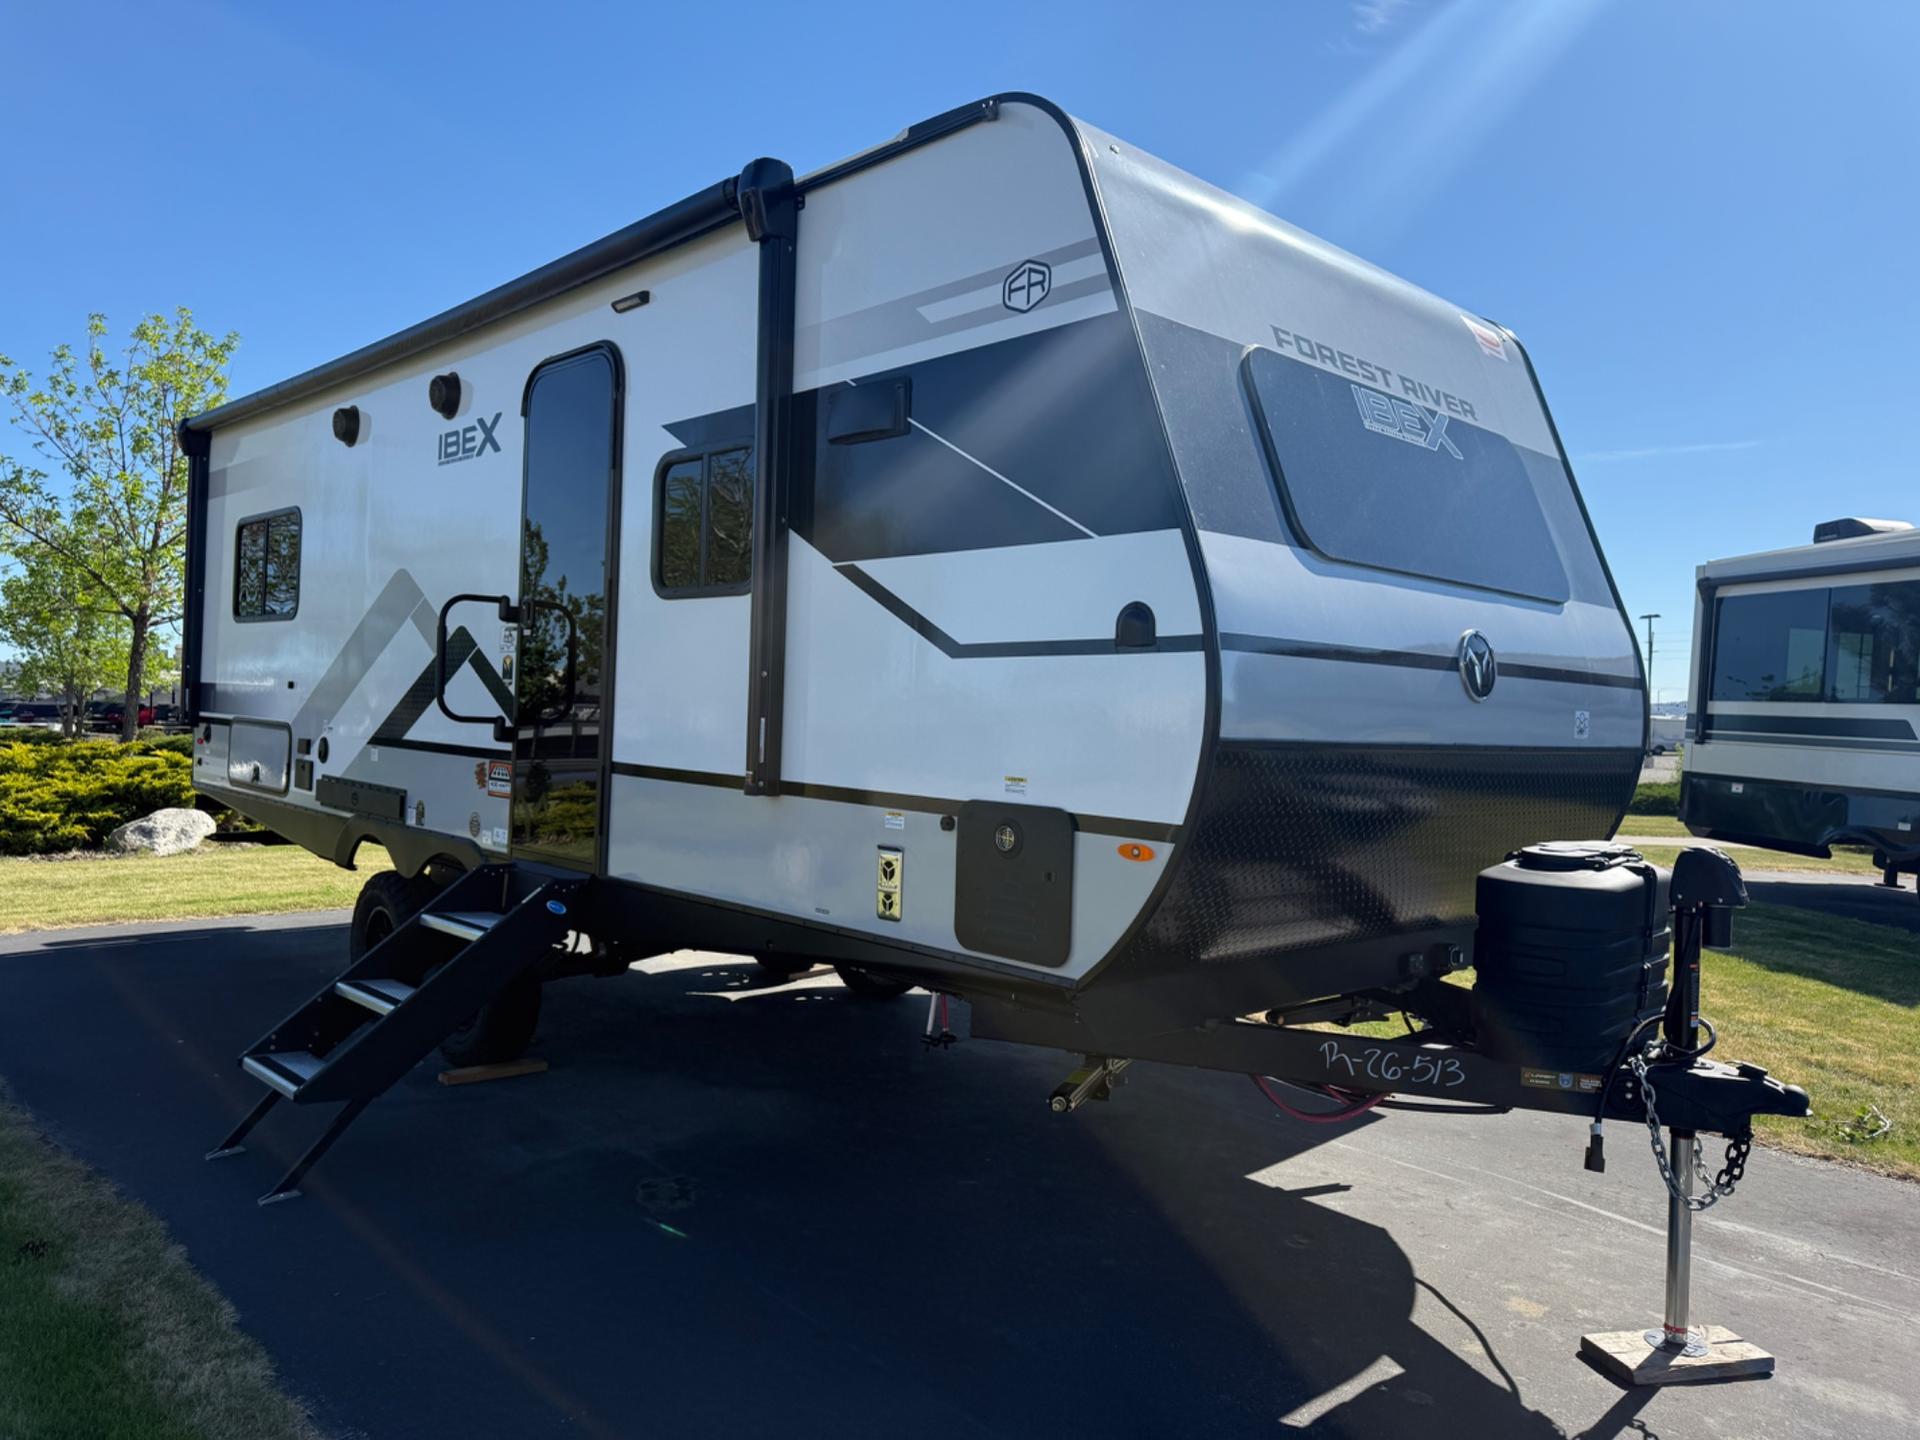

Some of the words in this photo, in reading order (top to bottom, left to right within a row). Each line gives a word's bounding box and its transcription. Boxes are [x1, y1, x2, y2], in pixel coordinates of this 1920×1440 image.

[1269, 324, 1392, 389] FOREST
[1397, 373, 1479, 422] RIVER
[438, 411, 503, 461] IBEX
[1350, 383, 1464, 460] IBEX
